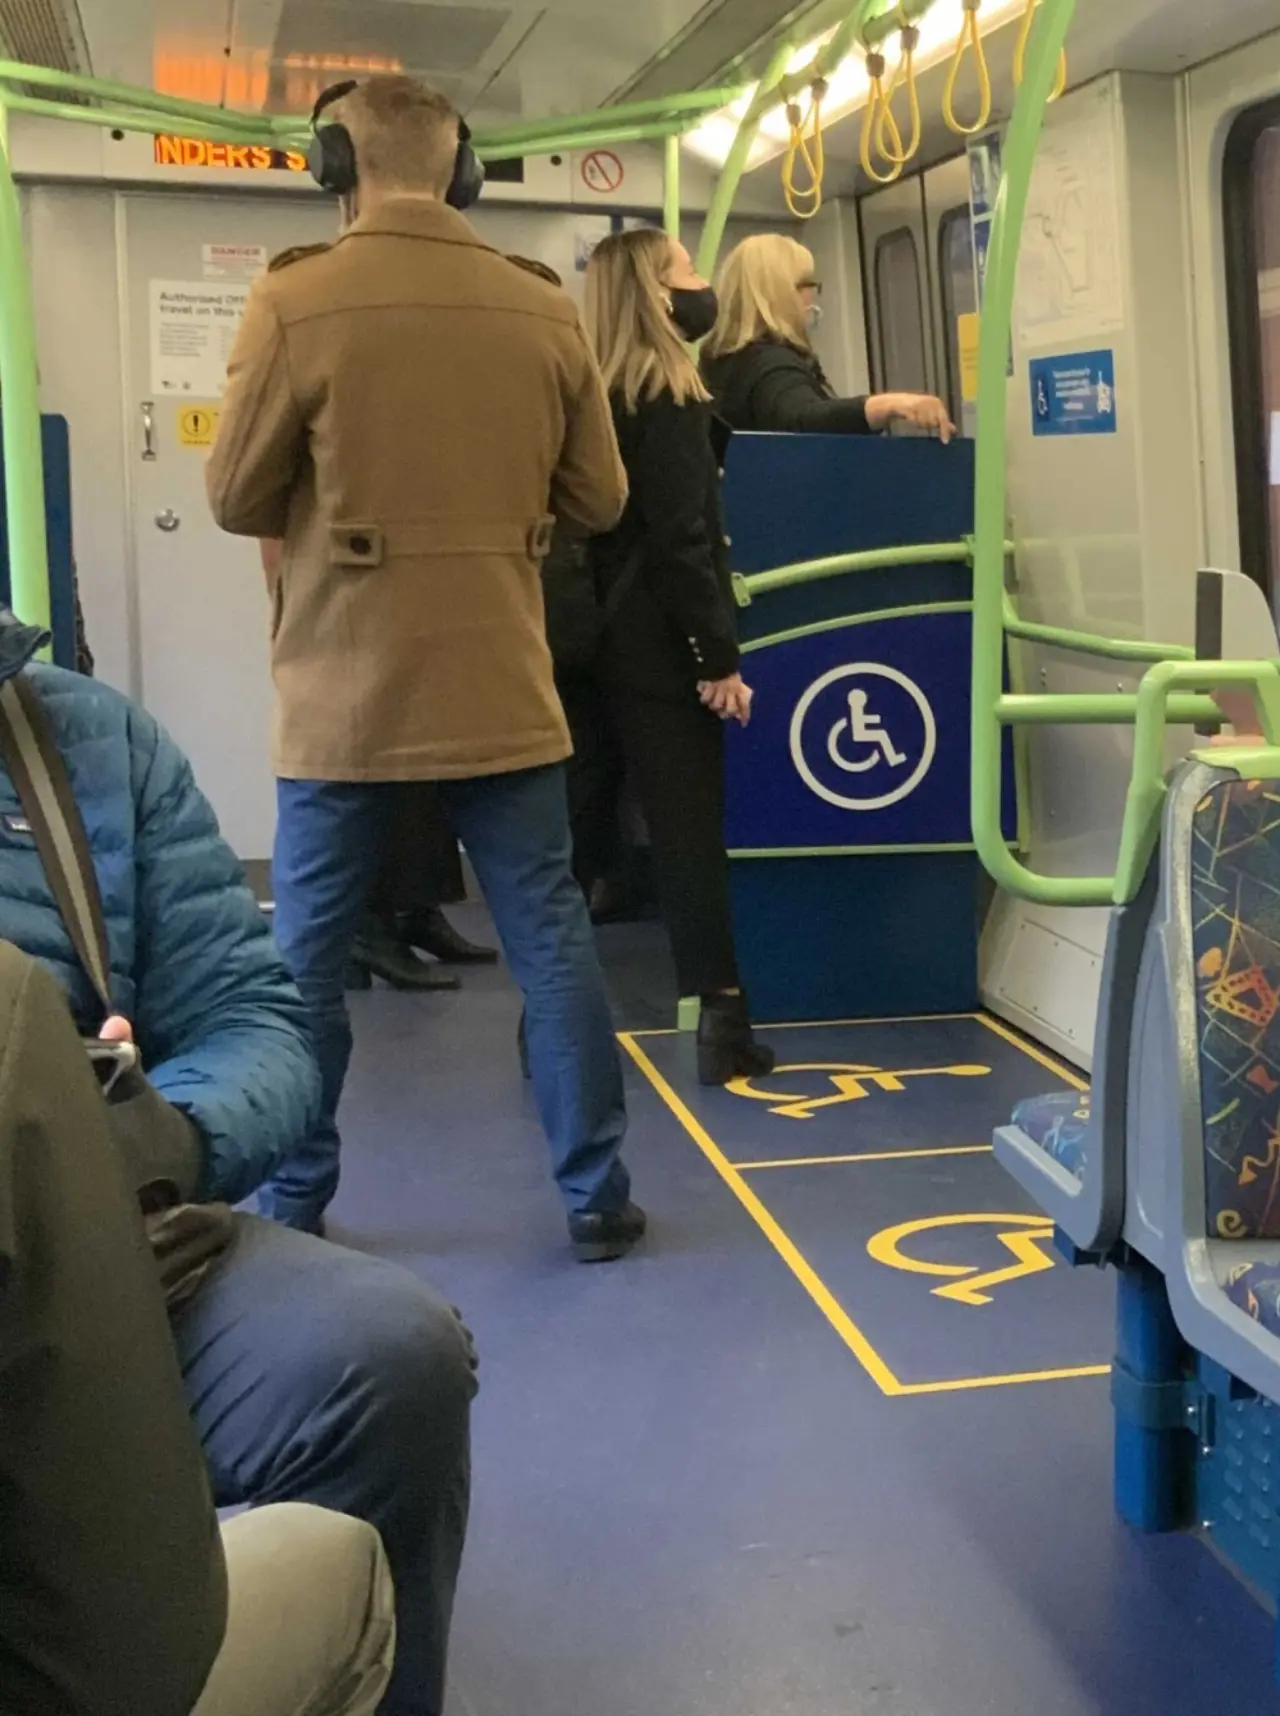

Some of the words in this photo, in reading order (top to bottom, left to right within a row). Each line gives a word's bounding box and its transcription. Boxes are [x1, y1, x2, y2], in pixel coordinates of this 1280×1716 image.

[210, 246, 261, 256] DANGER
[160, 291, 223, 305] Authorised
[160, 304, 192, 316] travel
[196, 306, 211, 315] on
[214, 306, 235, 317] this
